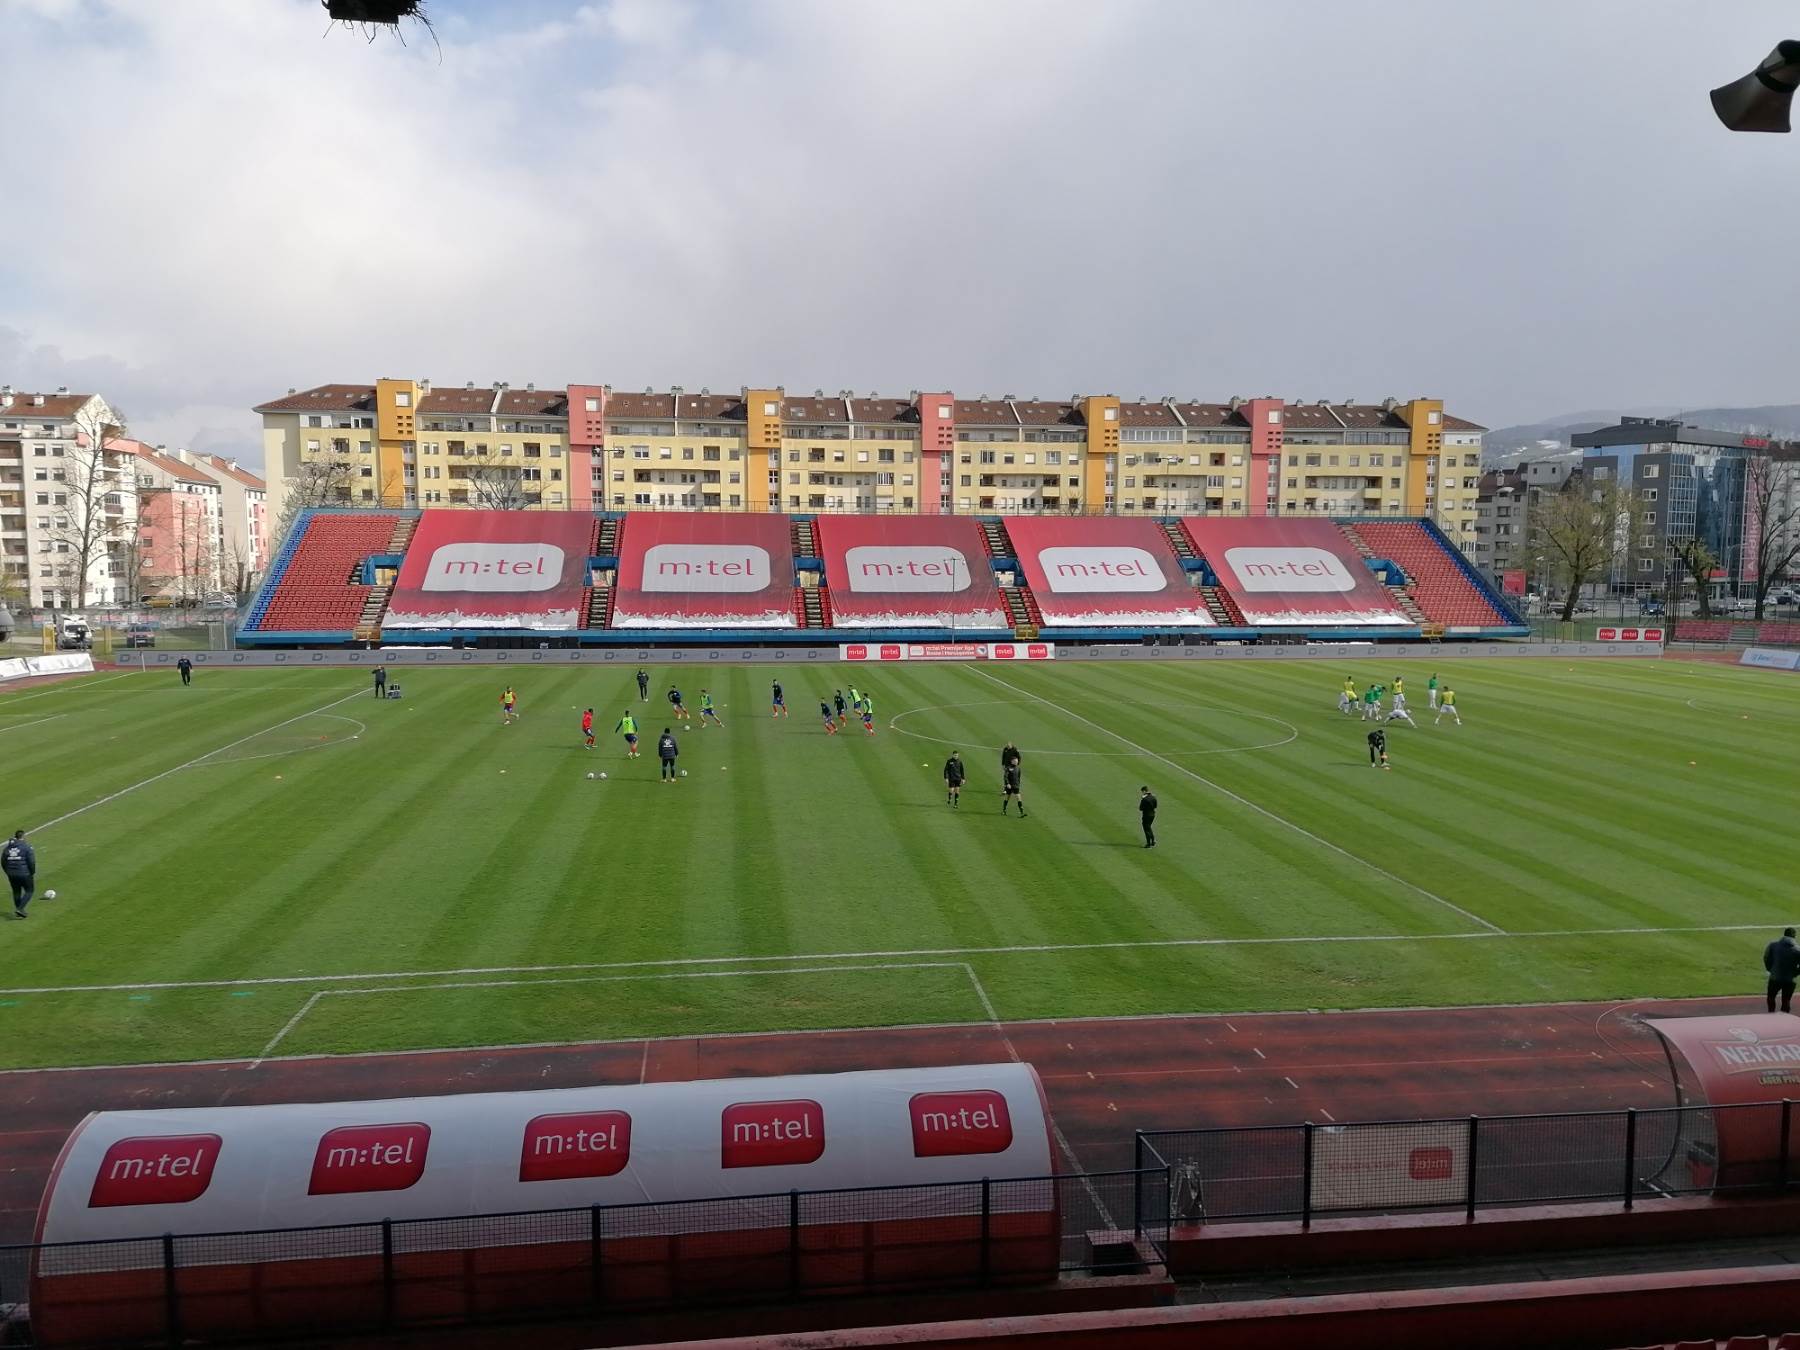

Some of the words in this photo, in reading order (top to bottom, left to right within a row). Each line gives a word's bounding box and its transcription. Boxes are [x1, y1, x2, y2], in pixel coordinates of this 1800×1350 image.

[445, 556, 544, 575] m:tel
[659, 559, 755, 576] m:tel
[862, 560, 954, 576] m:tel
[1057, 560, 1148, 576] m:tel
[1245, 560, 1335, 576] m:tel
[733, 1113, 813, 1142] m:tel
[922, 1103, 999, 1132] m:tel
[535, 1124, 617, 1155] m:tel
[110, 1148, 204, 1180] m:tel
[326, 1137, 414, 1168] m:tel
